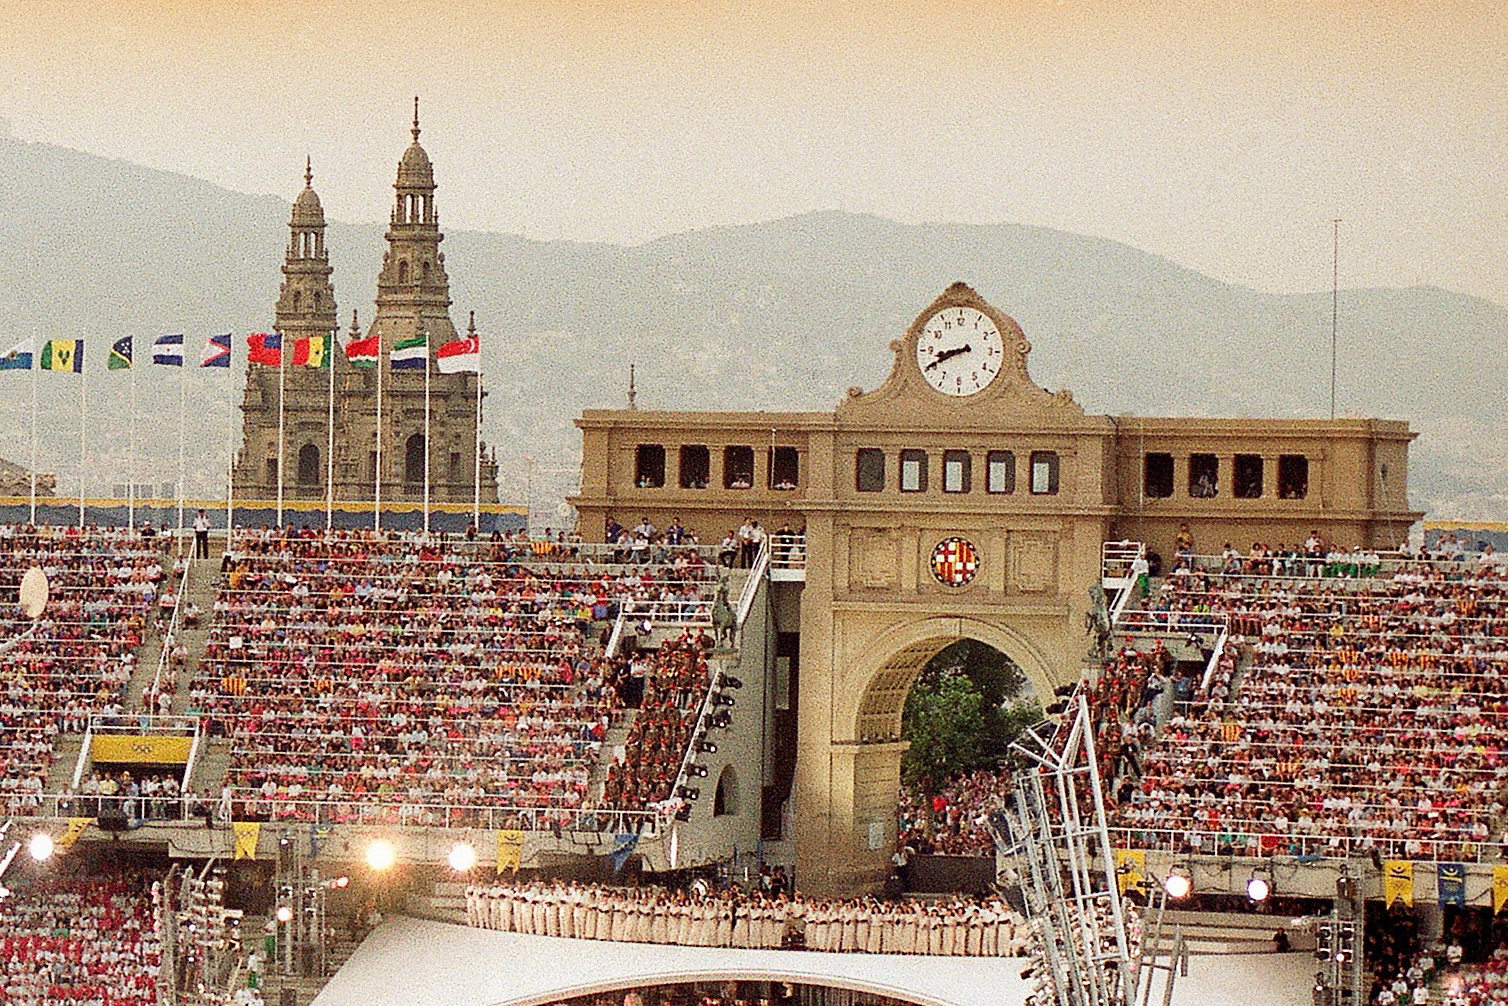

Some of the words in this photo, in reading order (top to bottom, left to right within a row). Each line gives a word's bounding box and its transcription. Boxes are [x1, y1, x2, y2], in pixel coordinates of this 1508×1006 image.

[944, 322, 952, 330] 11
[957, 318, 965, 326] 12
[934, 330, 942, 339] 10
[983, 332, 988, 340] 2
[928, 346, 934, 355] 9
[956, 376, 962, 386] 6
[972, 372, 978, 381] 5
